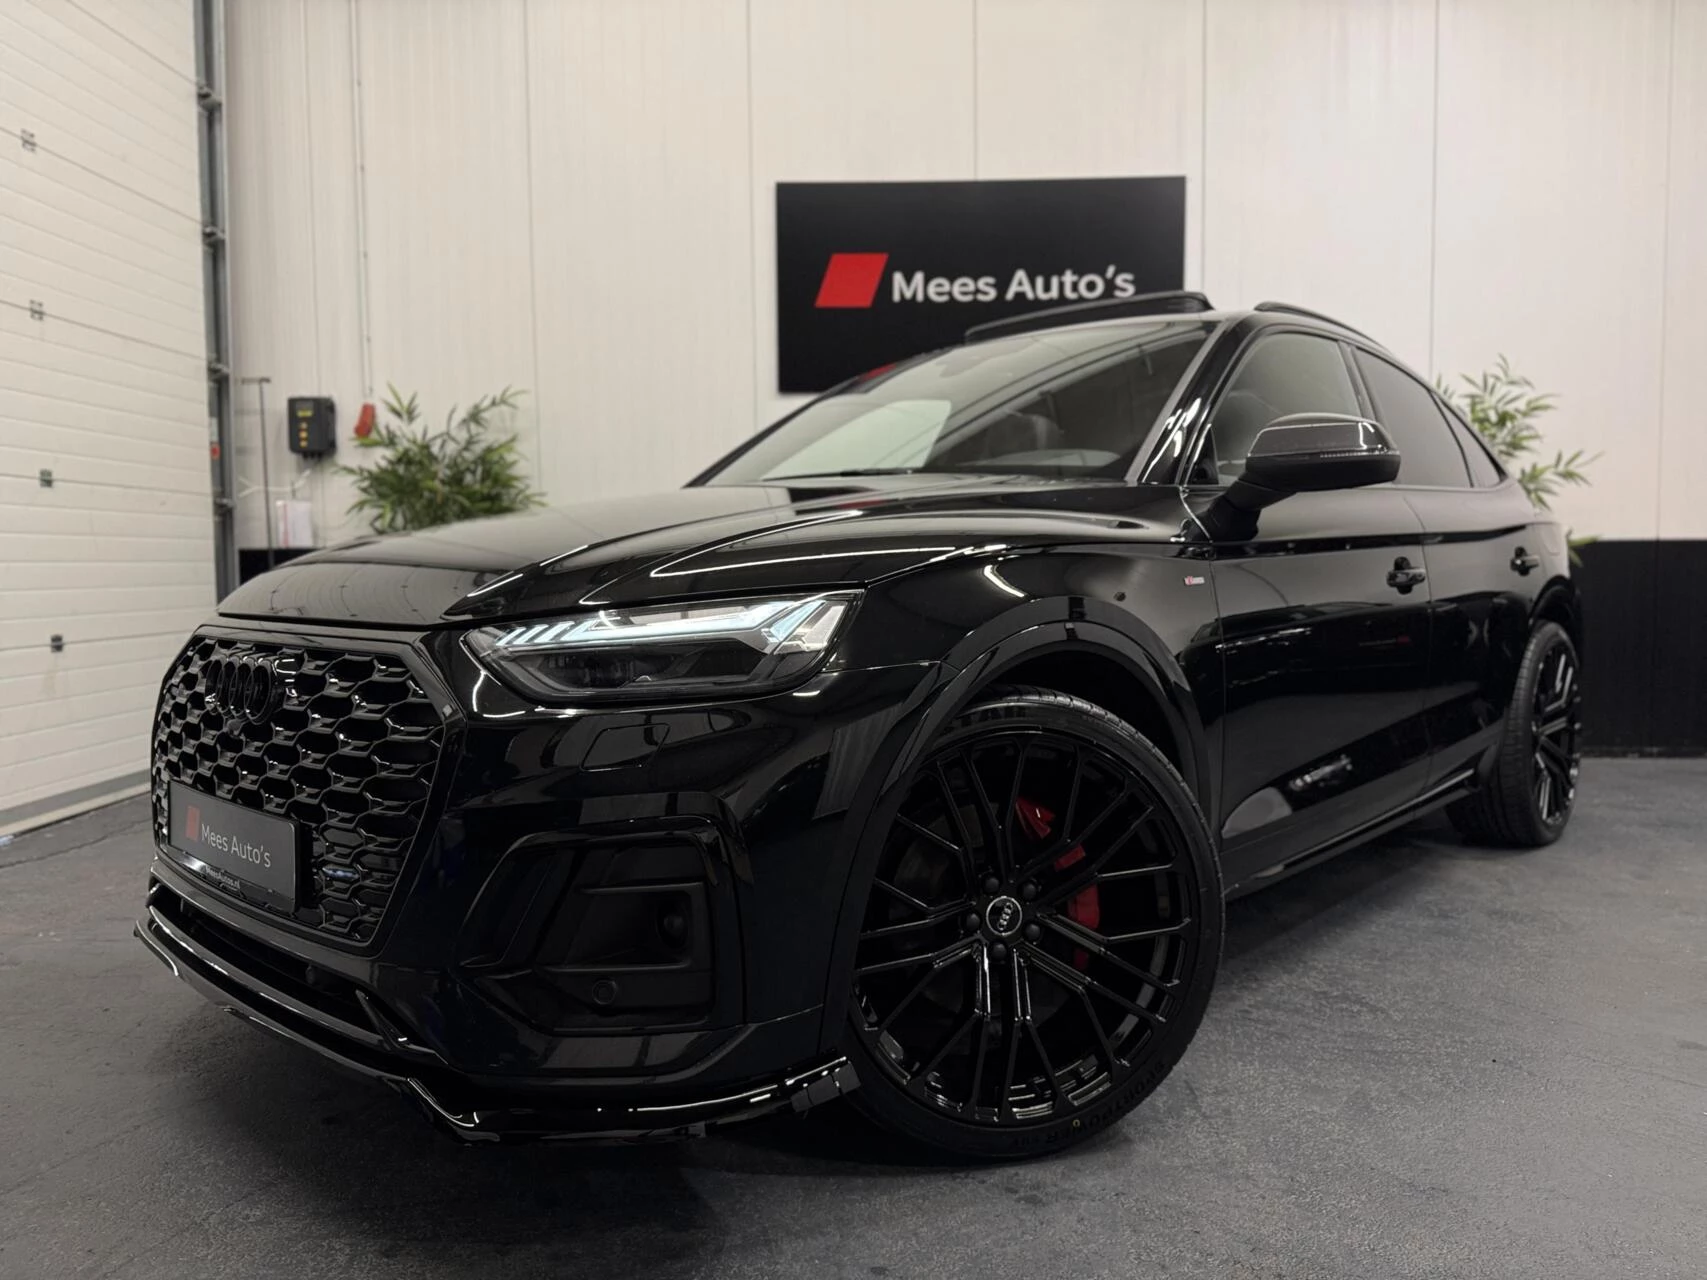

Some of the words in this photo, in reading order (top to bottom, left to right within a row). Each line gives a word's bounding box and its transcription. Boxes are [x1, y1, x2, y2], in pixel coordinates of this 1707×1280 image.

[892, 271, 997, 302] Mees
[1005, 265, 1136, 300] Auto's
[201, 823, 229, 852] Mees
[231, 835, 271, 868] Auto's
